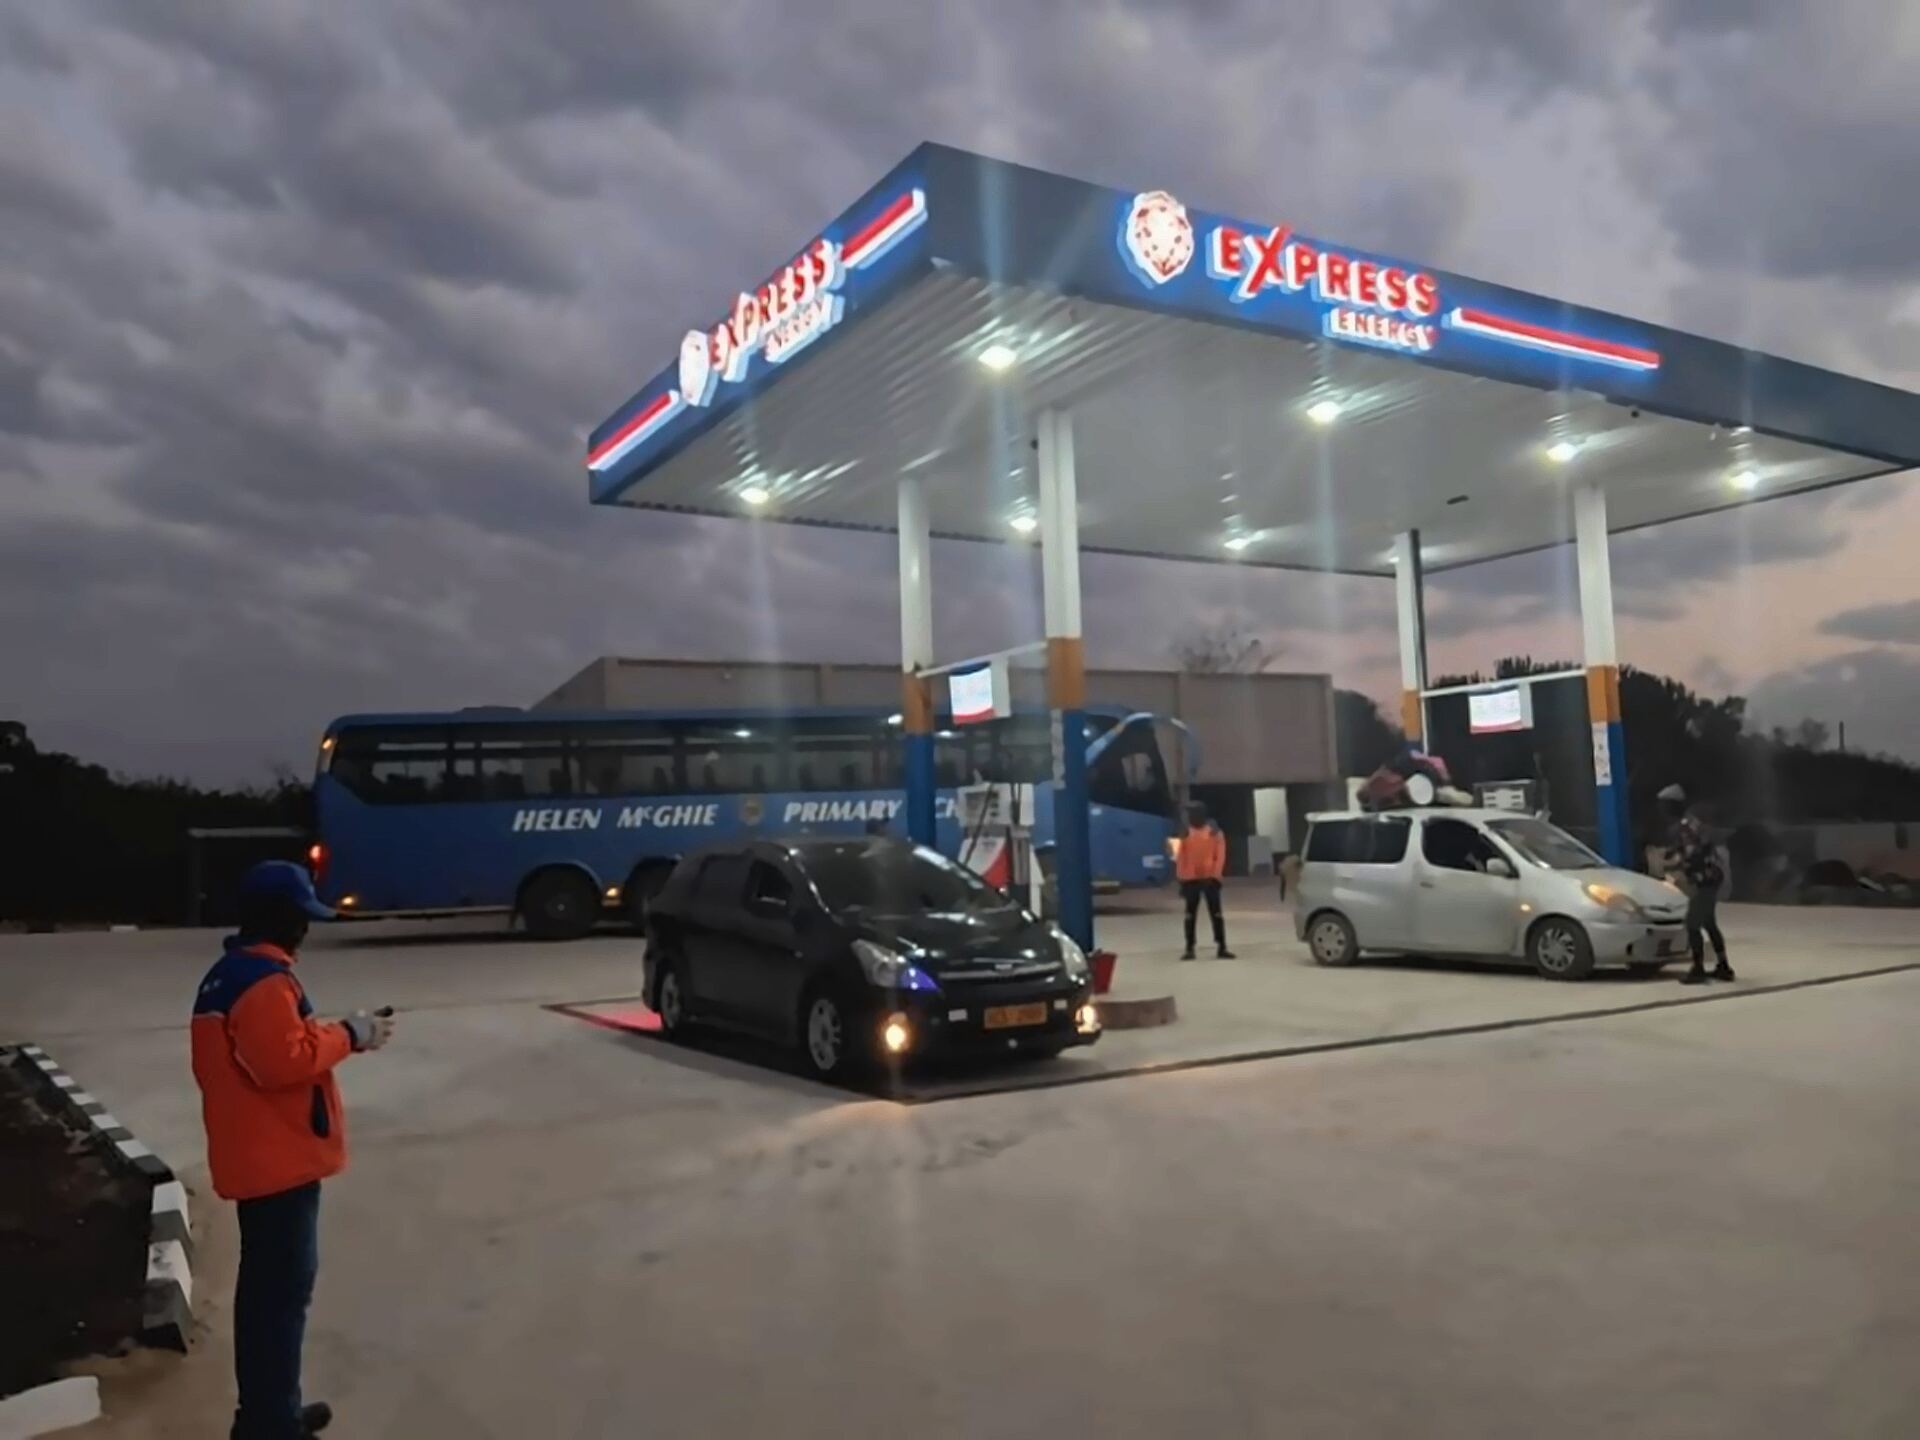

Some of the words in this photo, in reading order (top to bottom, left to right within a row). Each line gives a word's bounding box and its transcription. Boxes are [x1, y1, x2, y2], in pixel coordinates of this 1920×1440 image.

[1214, 222, 1440, 317] EXPRESS
[1331, 309, 1438, 350] ENERGY
[513, 808, 602, 832] HELEN
[784, 799, 903, 823] PRIMARY
